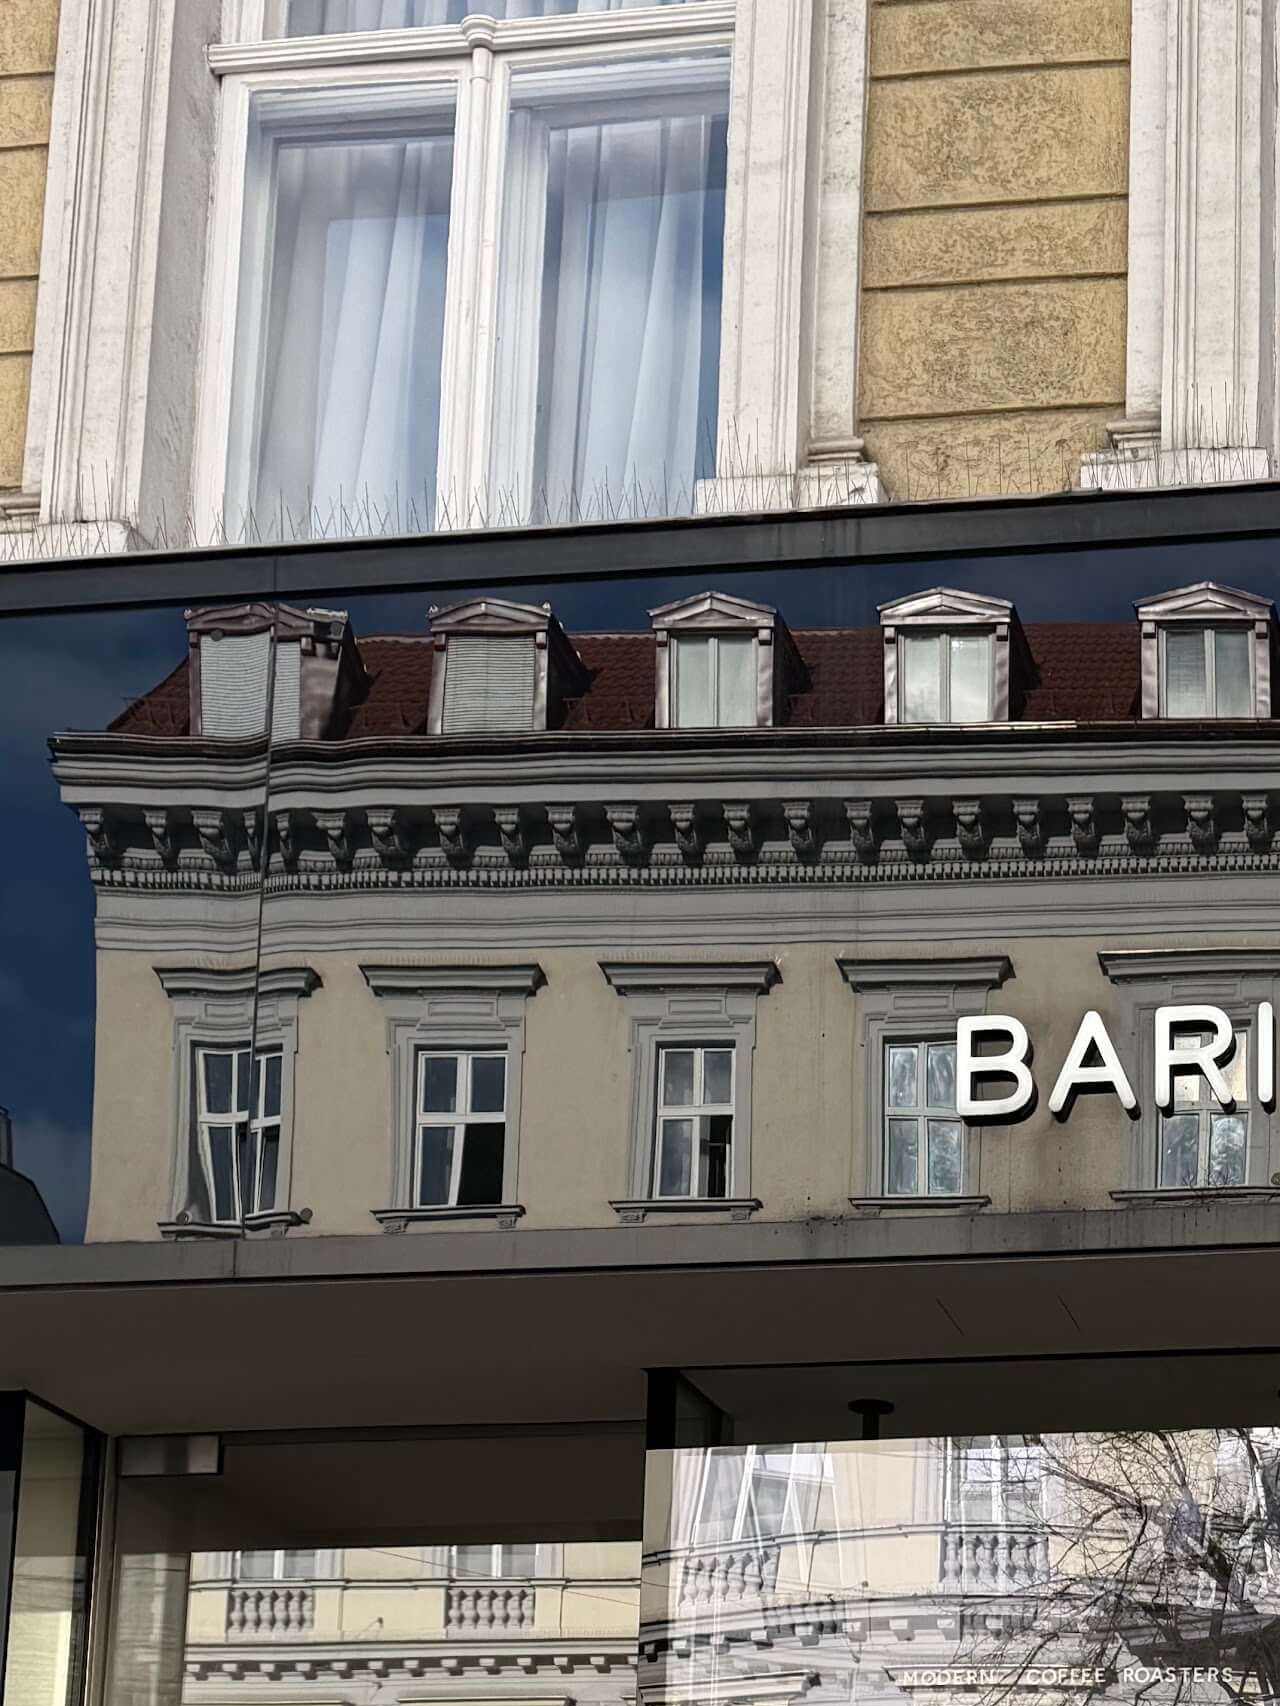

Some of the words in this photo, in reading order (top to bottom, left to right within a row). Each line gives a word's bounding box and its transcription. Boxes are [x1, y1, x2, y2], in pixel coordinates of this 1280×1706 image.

[903, 1669, 995, 1685] MODERN
[1026, 1667, 1106, 1684] COFFEE
[1123, 1666, 1234, 1683] ROASTERS
